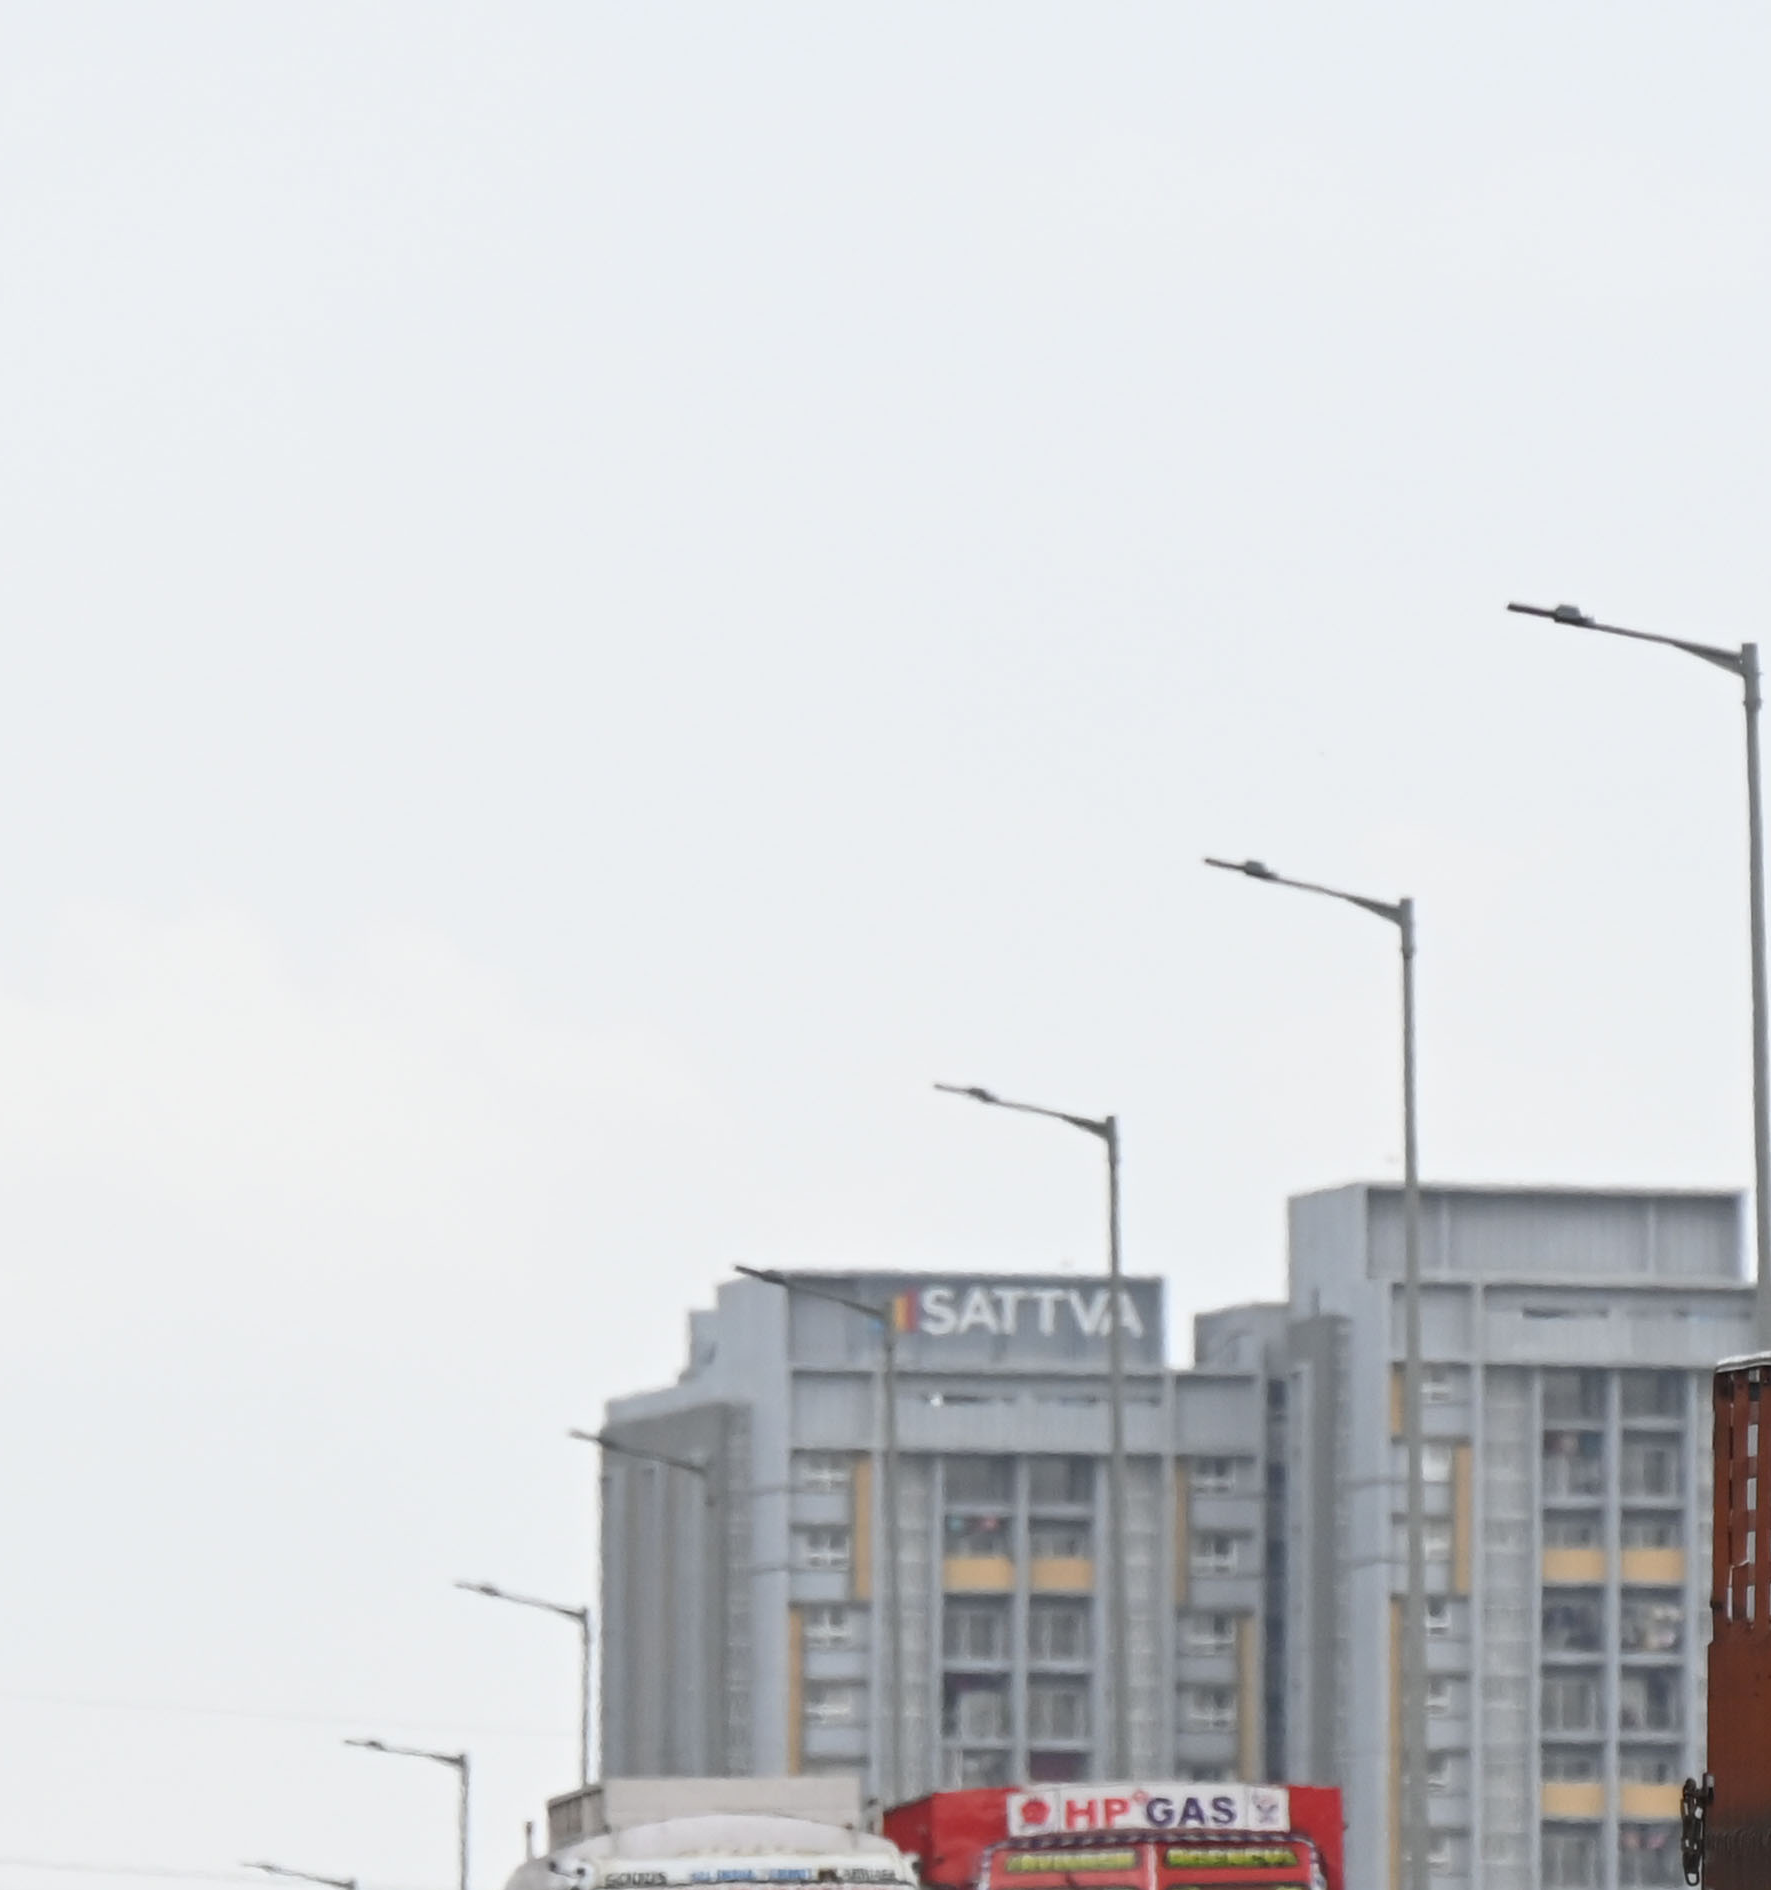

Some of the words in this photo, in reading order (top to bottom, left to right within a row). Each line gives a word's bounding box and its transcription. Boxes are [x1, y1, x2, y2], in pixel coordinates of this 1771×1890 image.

[919, 1286, 1145, 1338] SATTVA
[1064, 1797, 1130, 1830] HP
[1146, 1795, 1238, 1827] GAS
